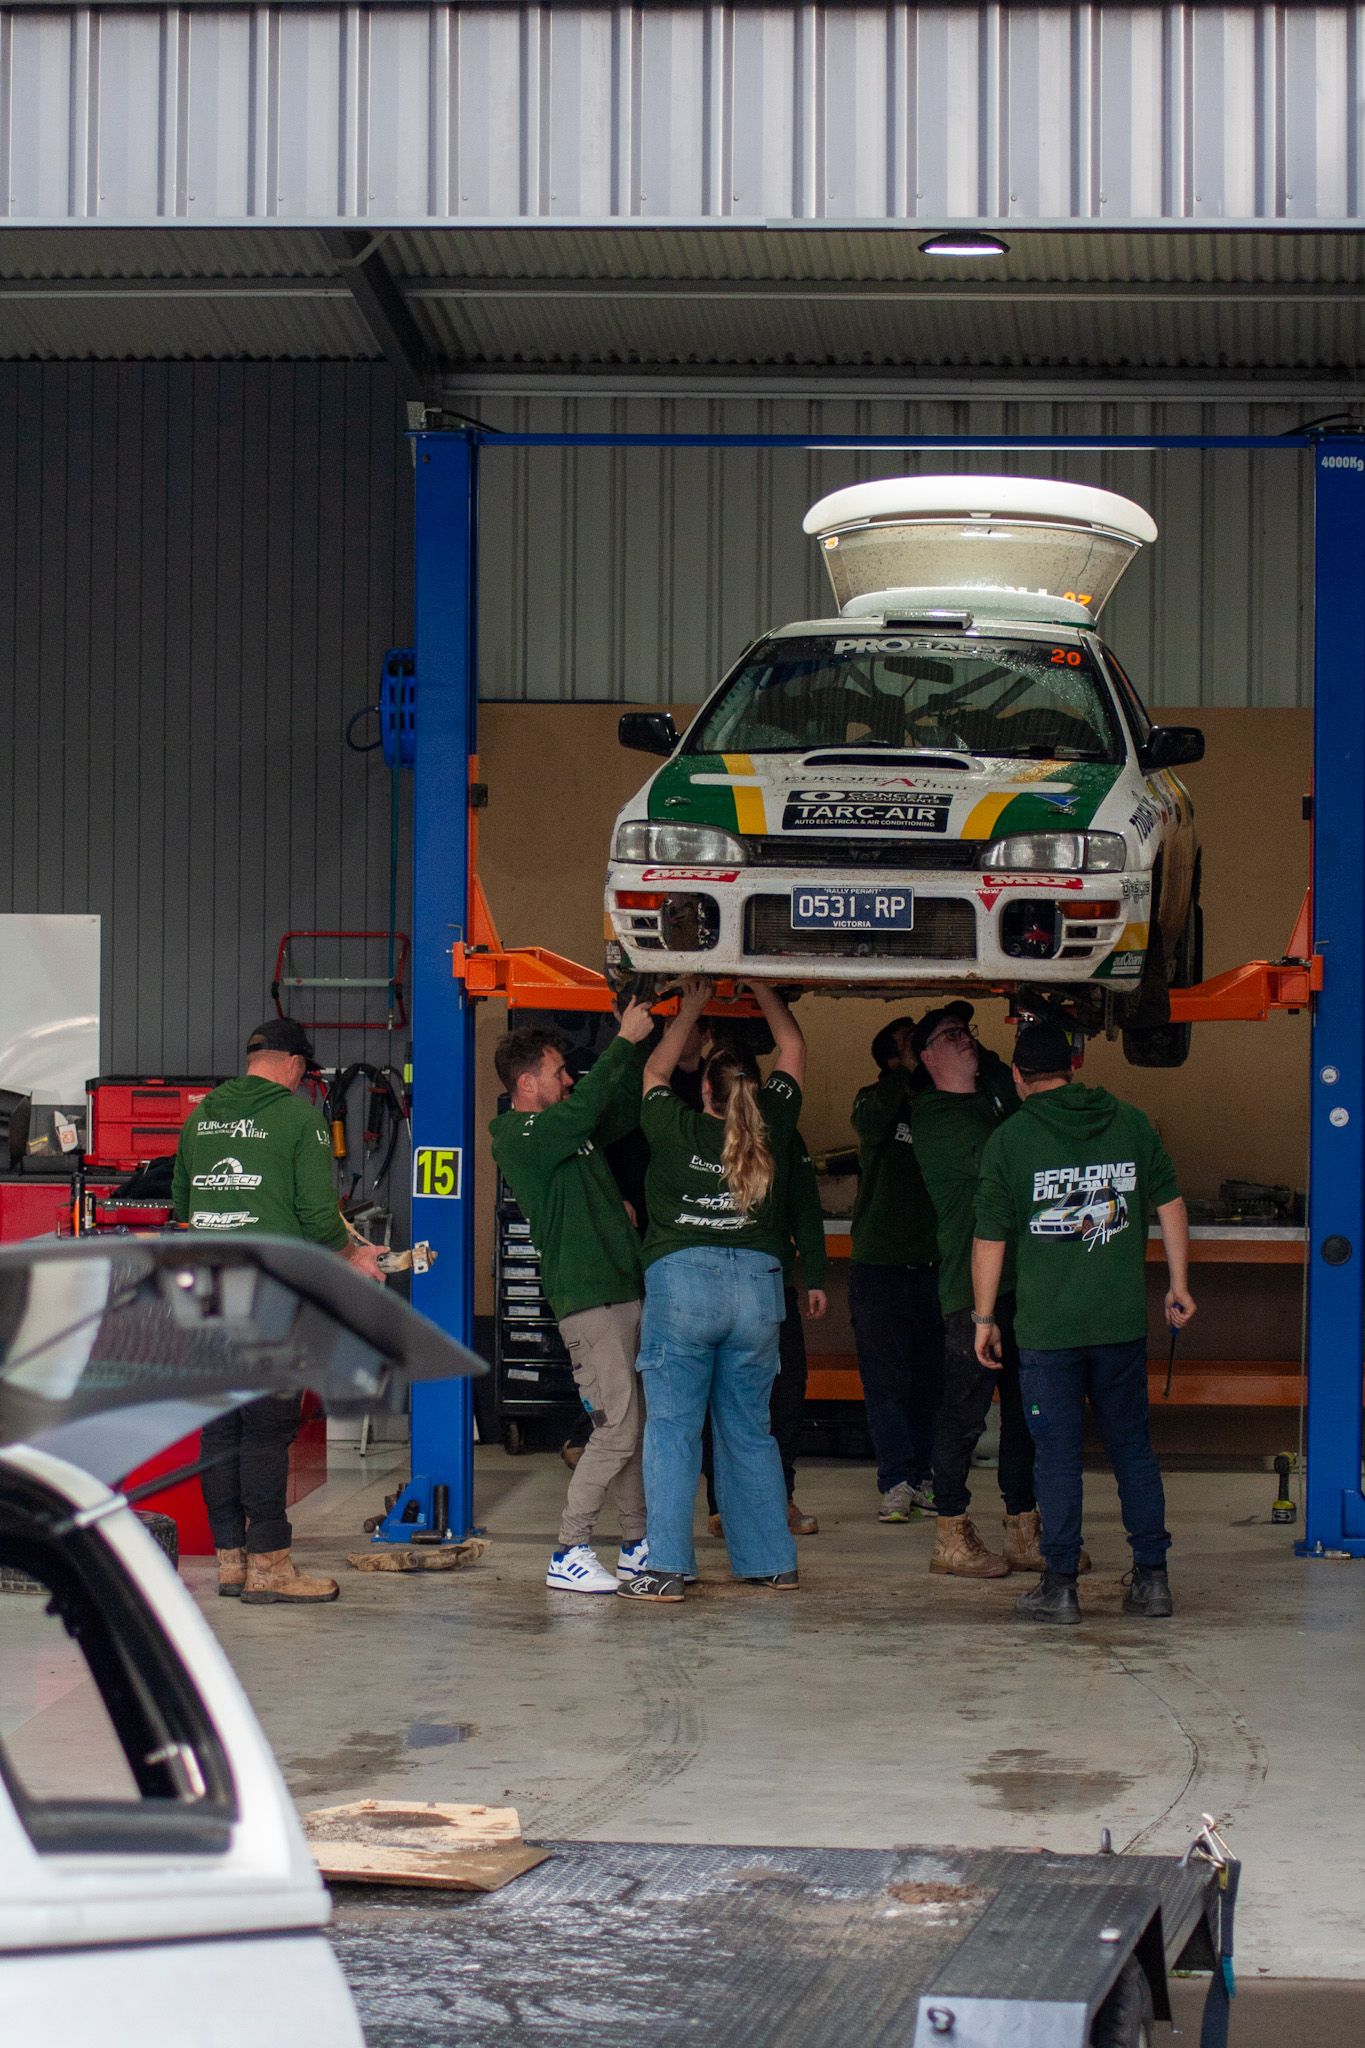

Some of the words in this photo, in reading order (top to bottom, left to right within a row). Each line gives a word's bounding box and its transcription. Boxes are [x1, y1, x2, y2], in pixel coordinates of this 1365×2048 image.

[1321, 456, 1364, 471] 4000Kg
[1051, 648, 1081, 666] 20
[848, 792, 939, 800] CONCEPT
[798, 806, 936, 820] TARC-AIR
[880, 820, 935, 828] CONDITIONING
[652, 869, 736, 879] MRF
[989, 875, 1079, 886] MRF
[799, 895, 856, 917] 0531
[875, 896, 906, 918] RP
[833, 920, 871, 928] VICTORIA
[418, 1151, 454, 1195] 15
[1033, 1162, 1136, 1188] SPALDING
